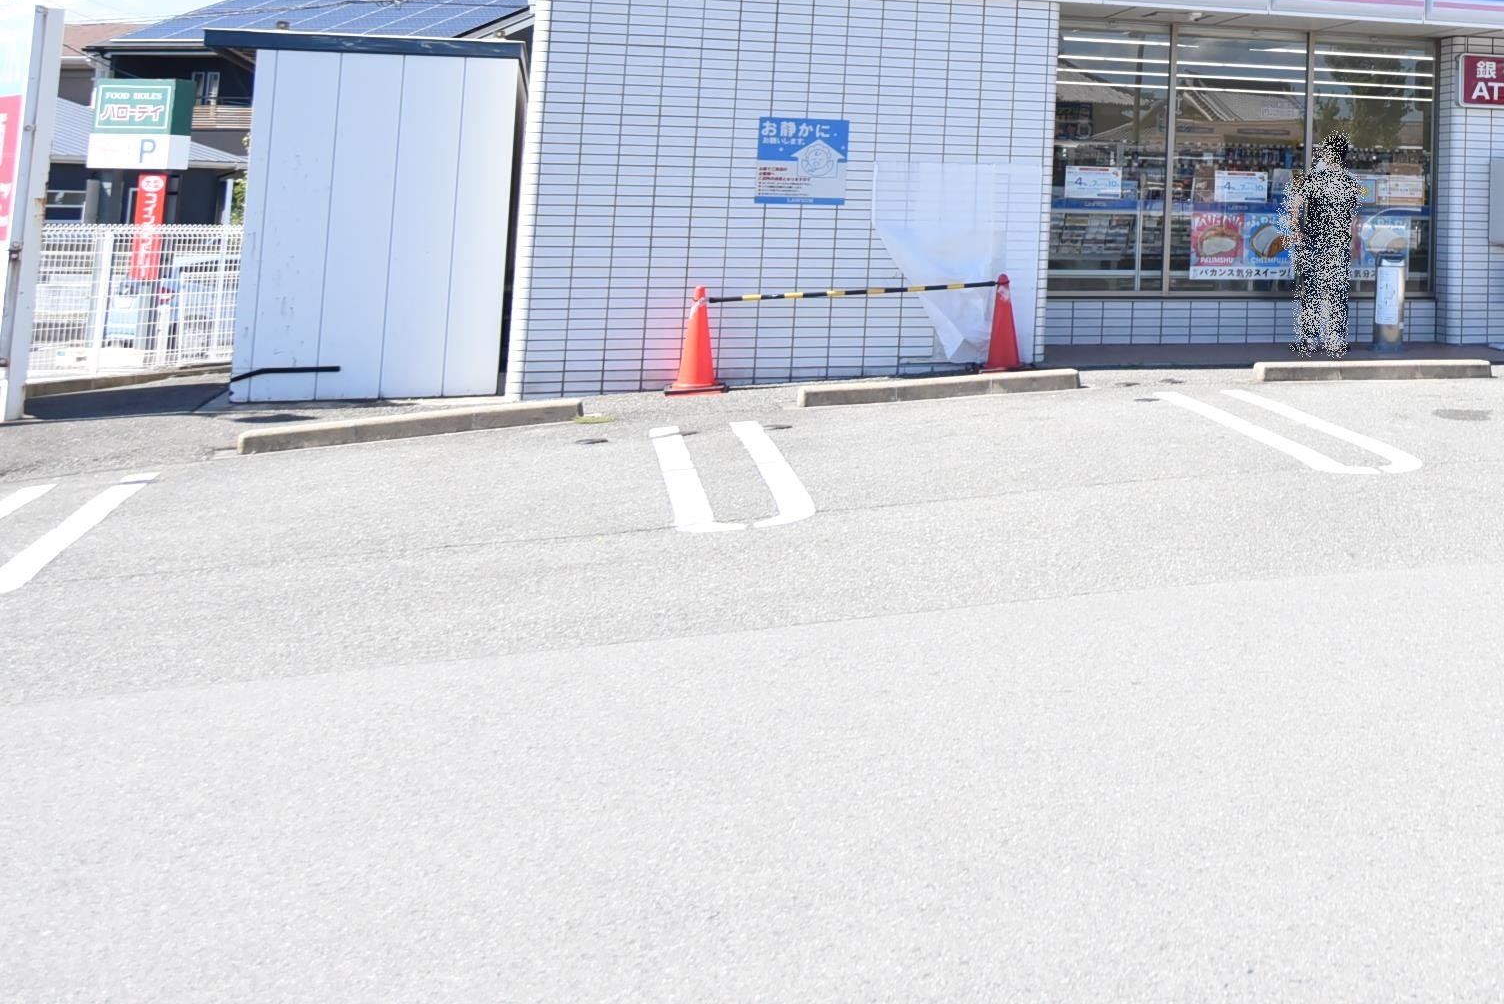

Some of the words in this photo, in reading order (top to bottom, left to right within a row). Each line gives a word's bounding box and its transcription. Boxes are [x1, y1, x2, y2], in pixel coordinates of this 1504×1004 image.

[761, 120, 831, 137] お静かに
[139, 139, 156, 163] P
[1200, 267, 1291, 278] バカンス気分スイーツ!
